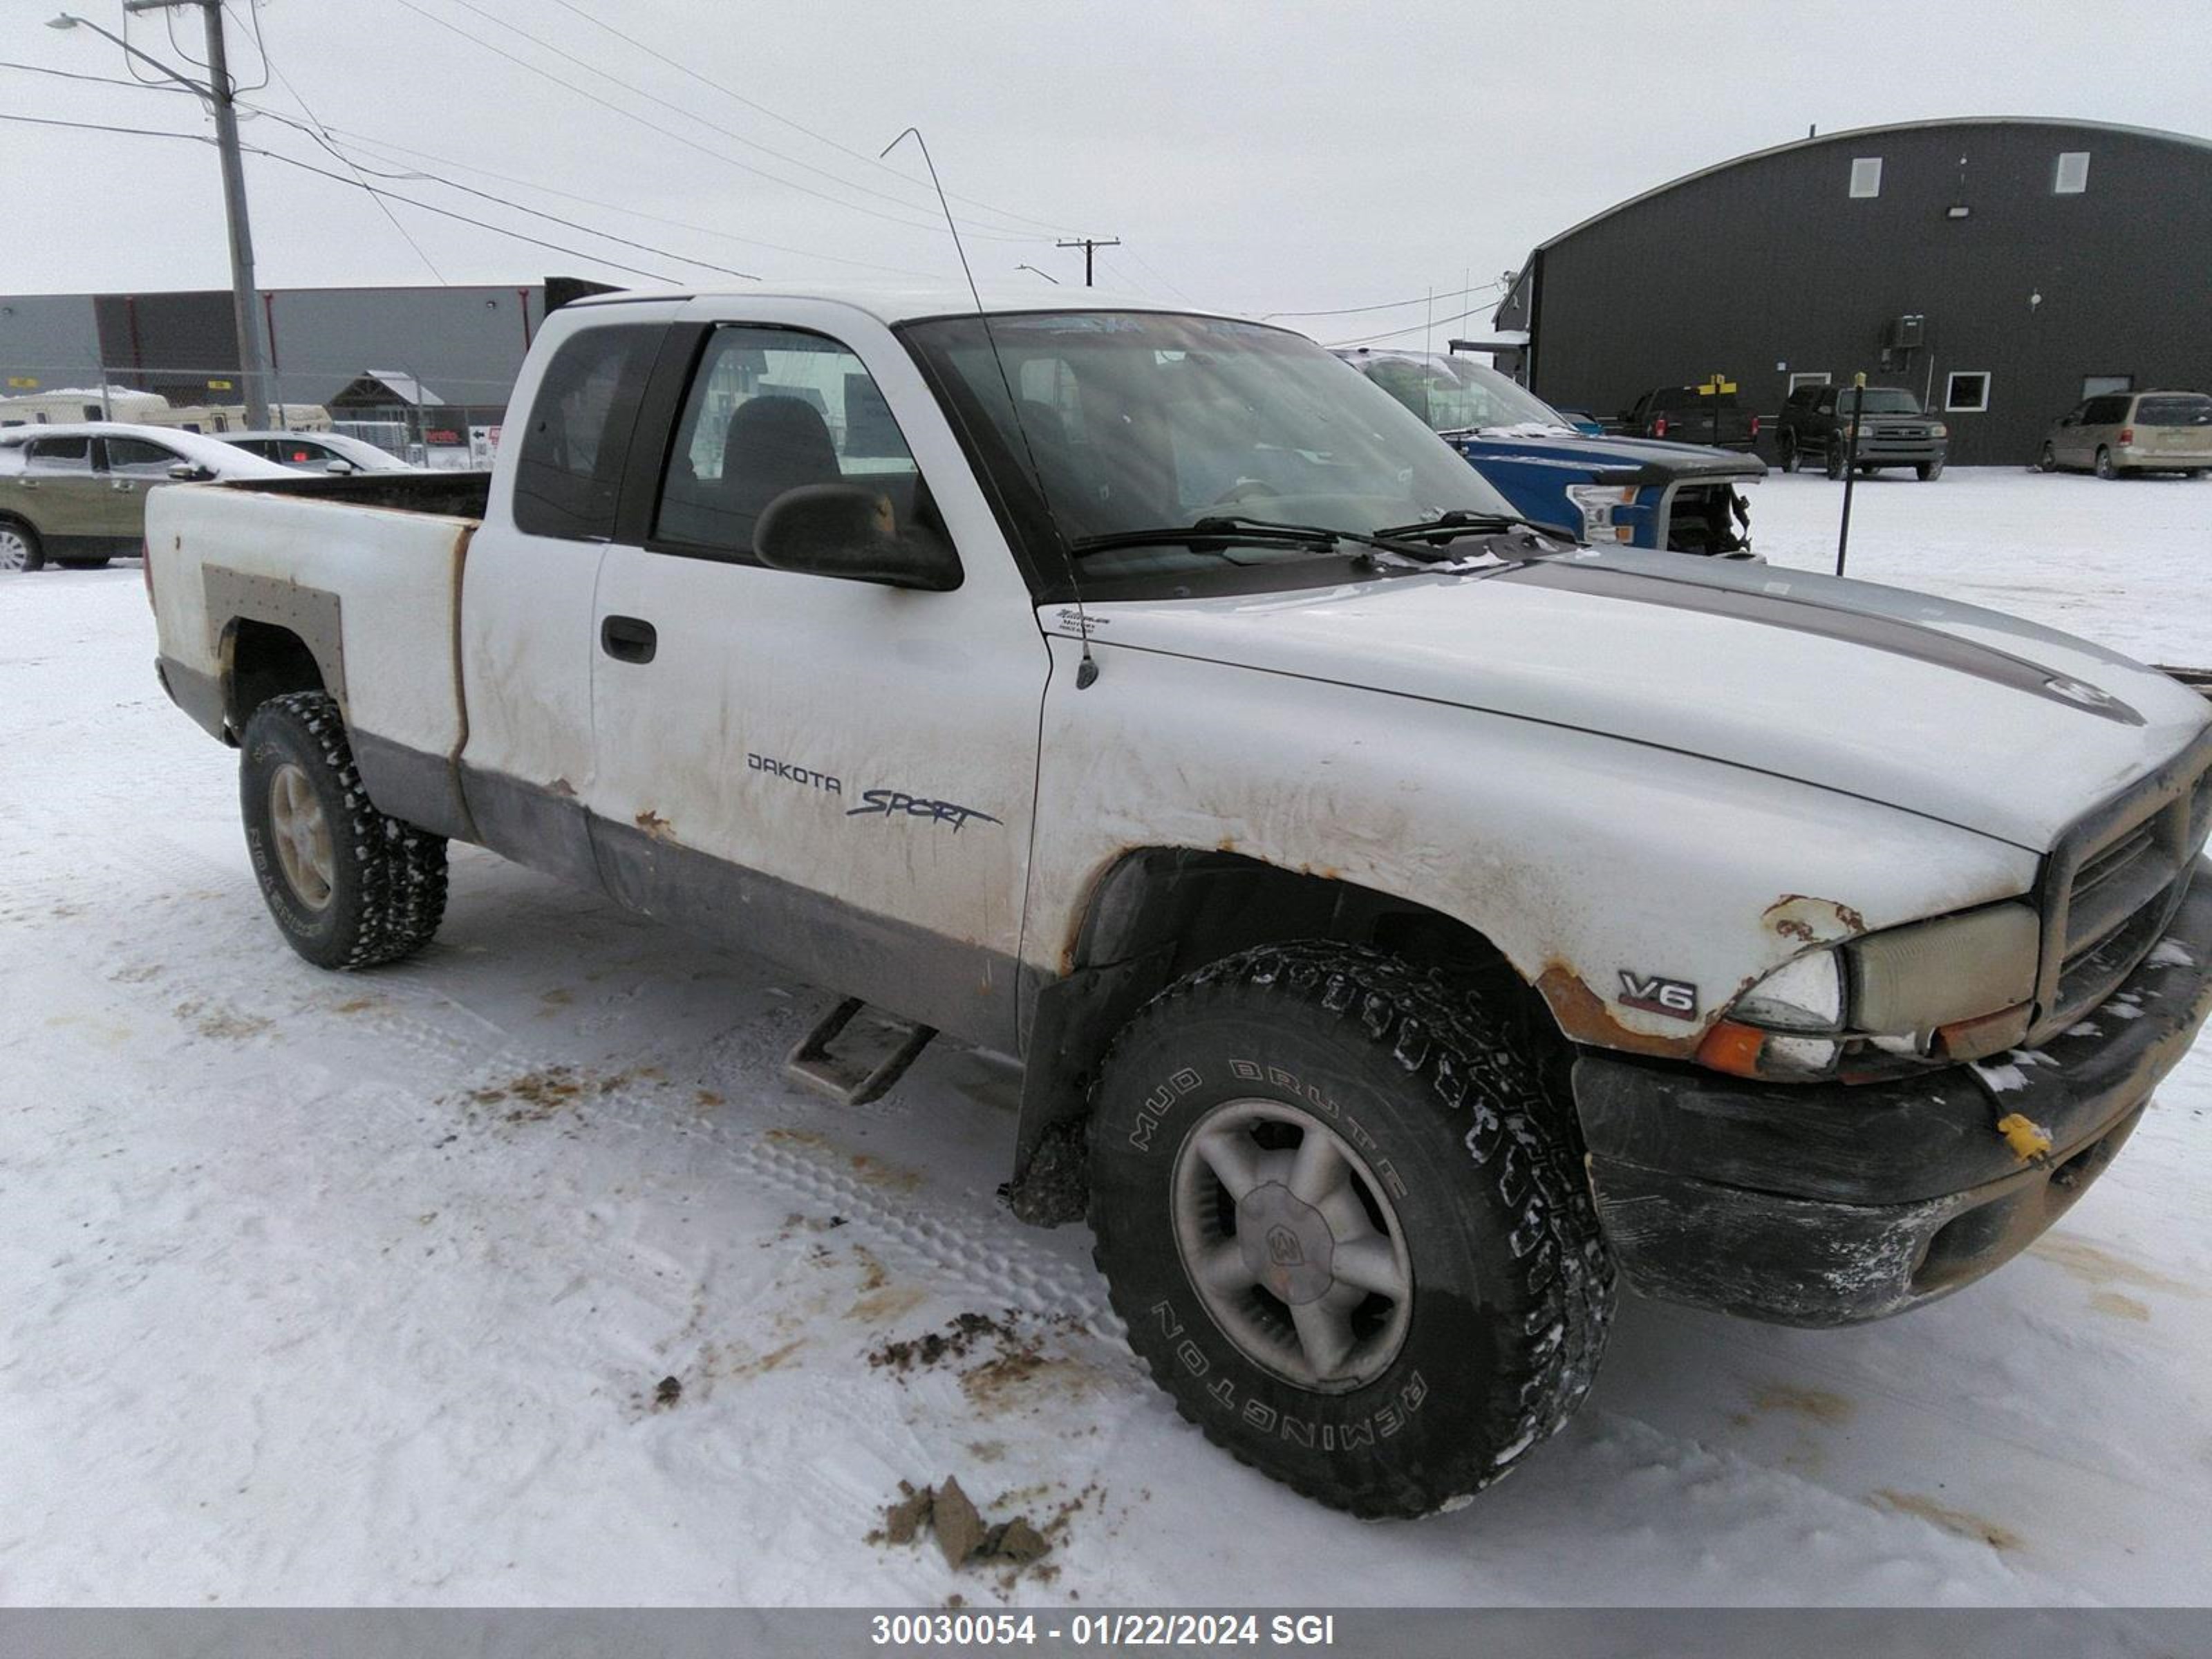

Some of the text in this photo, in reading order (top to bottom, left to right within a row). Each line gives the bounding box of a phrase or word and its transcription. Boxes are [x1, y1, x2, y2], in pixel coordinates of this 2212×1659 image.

[747, 752, 1004, 834] DAKOTA SPORT
[1620, 972, 1695, 1012] V6
[1127, 1058, 1410, 1201] MUD BRUTE
[1150, 1300, 1431, 1453] REMINGTON
